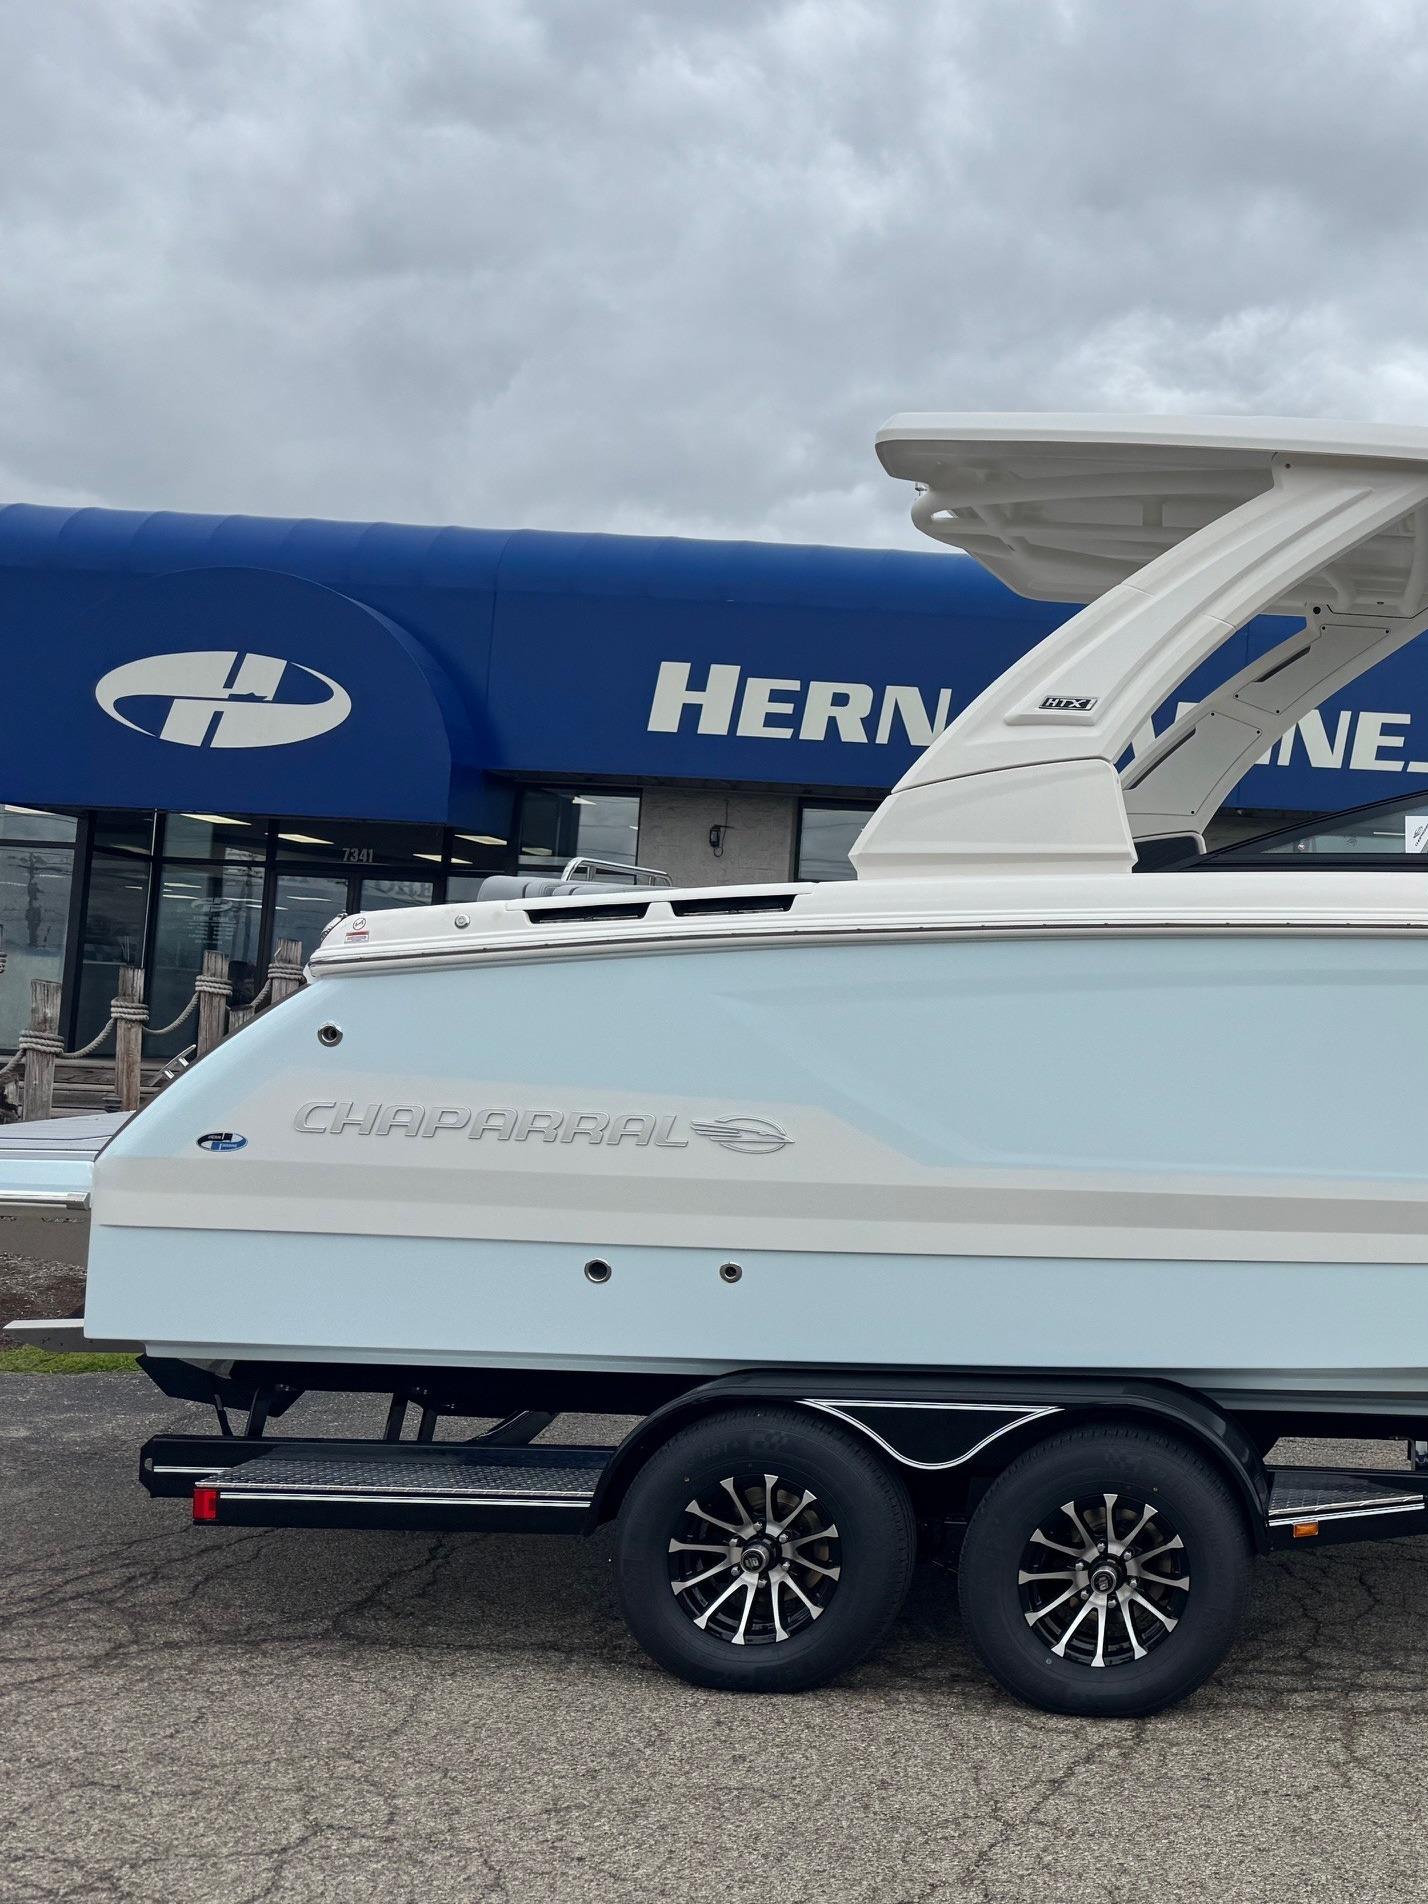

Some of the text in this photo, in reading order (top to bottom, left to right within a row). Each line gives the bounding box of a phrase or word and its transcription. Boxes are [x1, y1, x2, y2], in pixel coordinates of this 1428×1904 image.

[647, 661, 952, 747] HERN
[1045, 698, 1087, 708] HTX
[342, 848, 374, 862] 7341
[294, 1101, 690, 1148] CHAPARRAL
